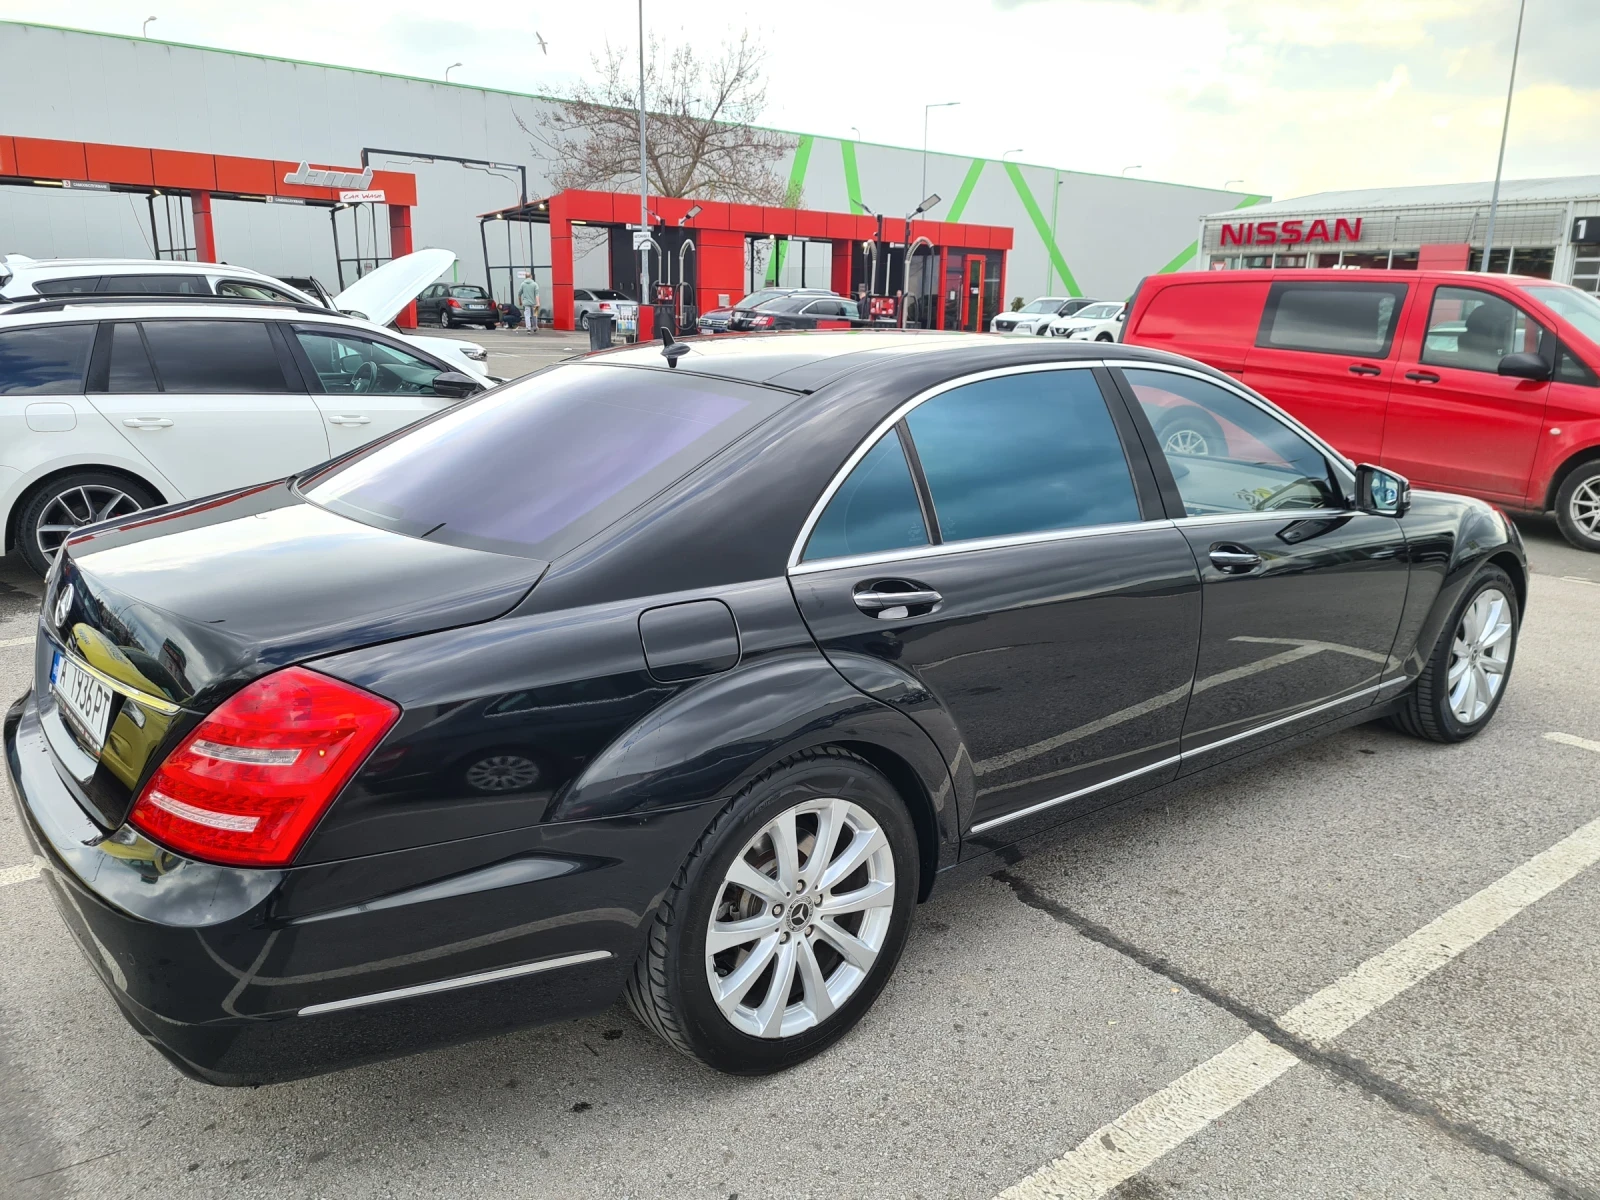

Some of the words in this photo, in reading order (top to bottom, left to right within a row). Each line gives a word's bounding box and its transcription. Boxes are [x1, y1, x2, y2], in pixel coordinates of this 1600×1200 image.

[1220, 217, 1363, 246] NISSAN
[1577, 219, 1587, 240] 1
[60, 660, 67, 689] A
